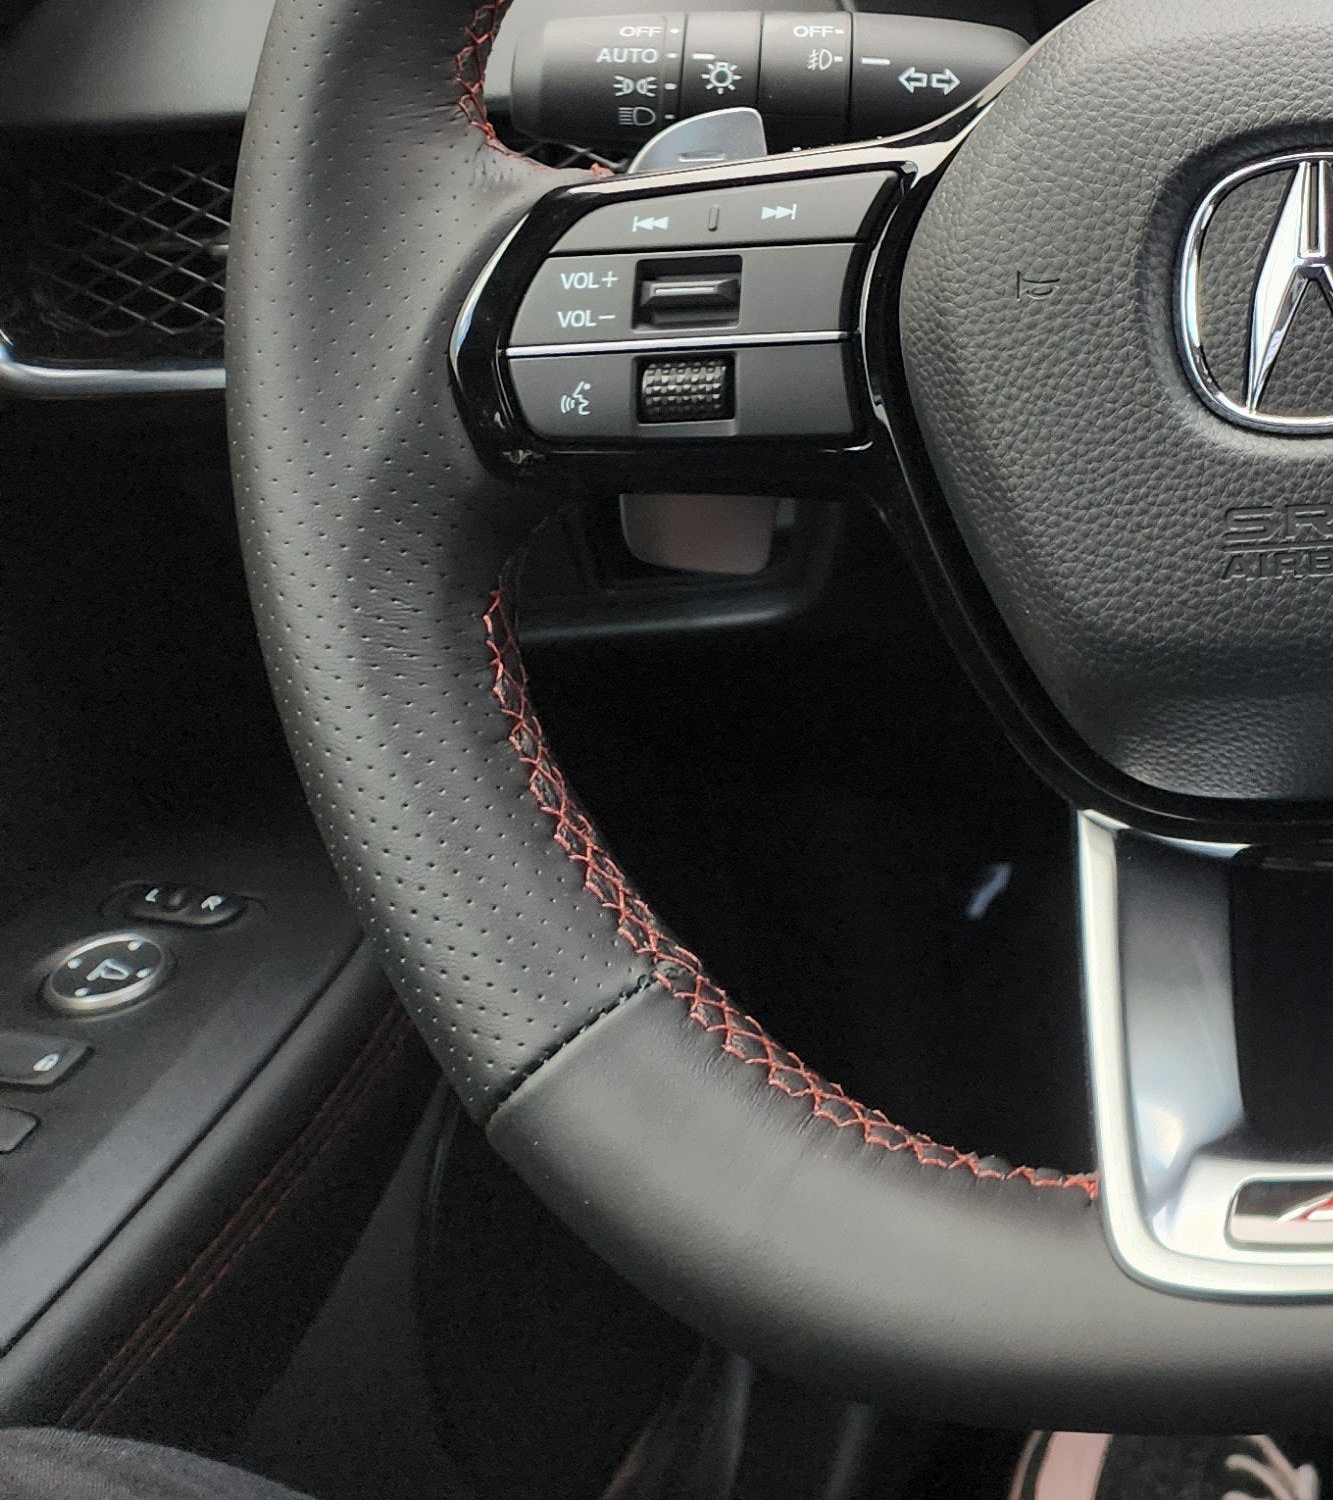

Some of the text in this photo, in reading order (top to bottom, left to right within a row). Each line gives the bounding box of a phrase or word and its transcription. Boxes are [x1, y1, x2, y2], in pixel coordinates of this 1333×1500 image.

[618, 25, 663, 38] OFF
[792, 24, 834, 38] OFF
[596, 47, 659, 64] AUTO
